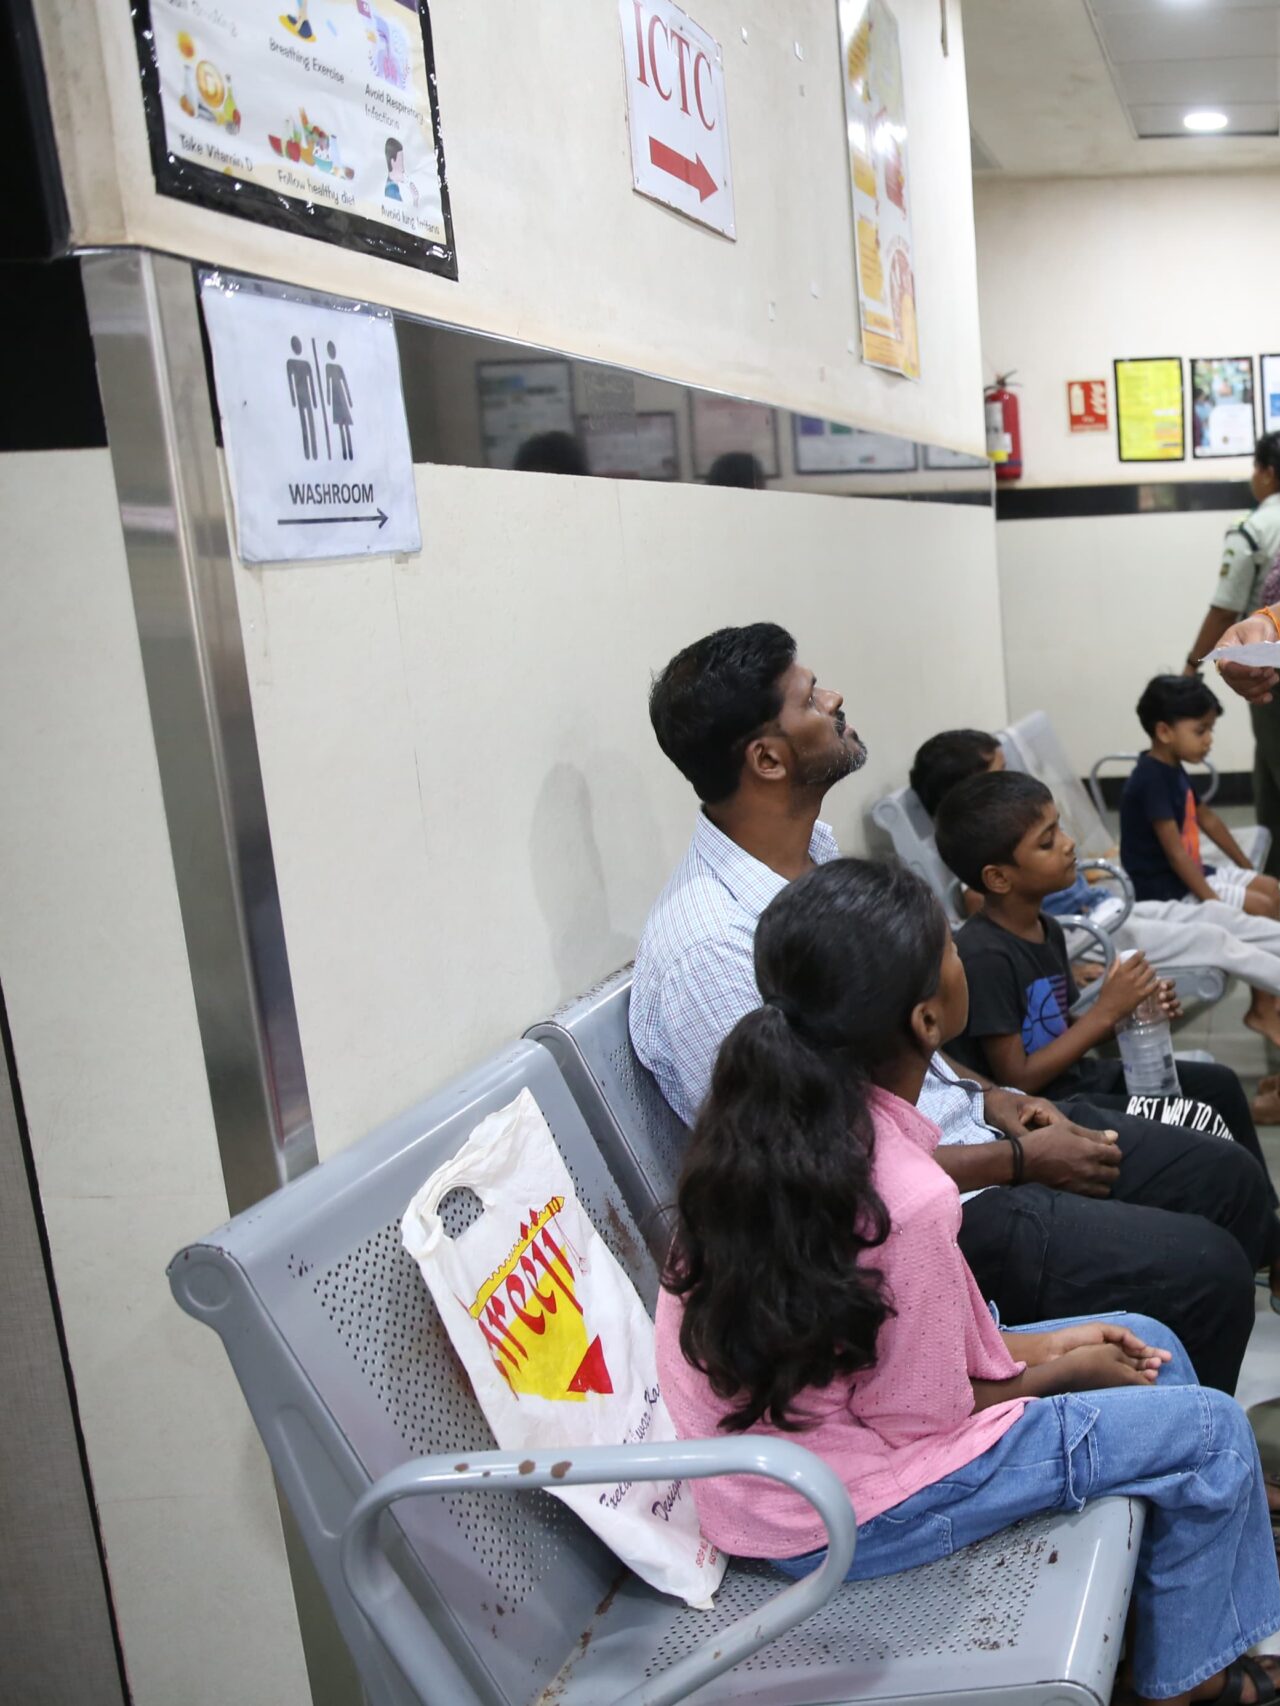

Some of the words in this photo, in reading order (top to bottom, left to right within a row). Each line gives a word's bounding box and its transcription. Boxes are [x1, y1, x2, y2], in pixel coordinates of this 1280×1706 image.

[269, 37, 310, 71] Breathing
[312, 56, 345, 84] Exercise
[633, 0, 715, 131] ICTC
[365, 83, 384, 103] Avoid
[386, 94, 423, 126] Respiratory
[179, 134, 203, 154] Take
[206, 143, 243, 168] Vitamin
[278, 169, 305, 189] Follow
[307, 178, 339, 205] healthy
[381, 204, 400, 222] Avoid
[289, 483, 374, 505] WASHROOM
[1161, 1096, 1193, 1127] WAY
[1190, 1102, 1212, 1131] TO
